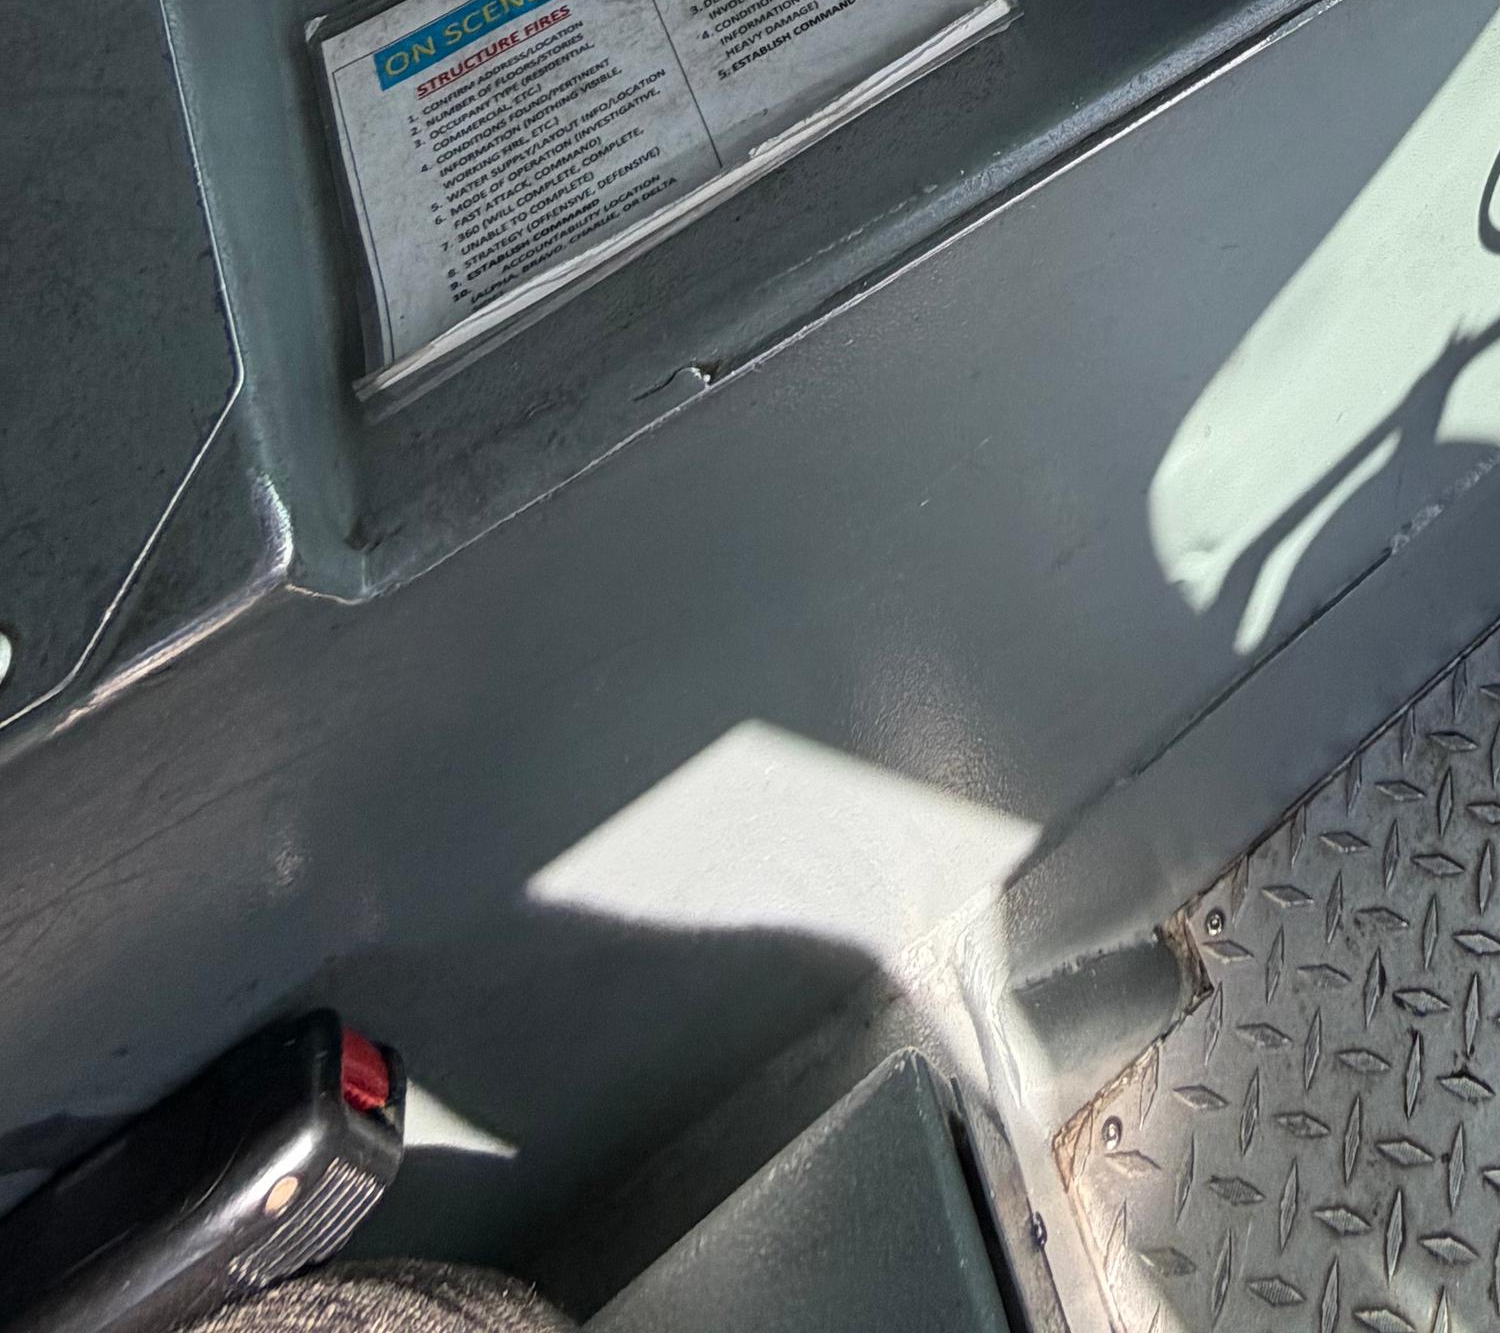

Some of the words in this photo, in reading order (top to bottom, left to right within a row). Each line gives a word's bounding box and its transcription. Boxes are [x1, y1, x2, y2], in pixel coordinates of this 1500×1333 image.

[416, 30, 520, 97] STRUCTURE
[522, 3, 571, 37] FIRES
[689, 2, 703, 15] 3.
[699, 27, 714, 42] 4.
[716, 65, 731, 81] 5.
[730, 30, 792, 73] ESTABLISH
[725, 30, 765, 59] HEAVY
[383, 35, 438, 80] ON
[407, 112, 419, 124] 1.
[422, 79, 475, 116] CONFIRM
[476, 18, 584, 85] ADDRESS/LOCATION
[409, 124, 422, 136] 2.
[425, 93, 476, 128] NUMBER
[477, 83, 493, 98] OF
[494, 31, 584, 87] FLOORS/STORIES
[412, 135, 425, 149] 3.
[492, 82, 518, 103] TYPE
[520, 38, 595, 87] (RESIDENTIAL,
[512, 82, 542, 106] ETC.)
[419, 161, 431, 173] 4.
[434, 117, 508, 166] CONDITIONS
[507, 56, 611, 122] FOUND/PERTINENT
[429, 198, 443, 212] 5.
[445, 172, 489, 204] WATER
[489, 118, 580, 177] SUPPLY/LAYOUT
[580, 67, 666, 123] INFO/LOCATION
[433, 212, 447, 226] 6.
[449, 188, 488, 217] MODE
[488, 177, 505, 193] OF
[506, 137, 572, 183] OPERATION
[573, 84, 660, 142] (INVESTIGATIVE,
[438, 123, 521, 177] INFORMATION
[522, 89, 579, 128] (NOTHING
[579, 63, 623, 95] VISIBLE,
[441, 151, 500, 192] WORKING
[530, 115, 560, 139] ETC.)
[441, 239, 453, 253] 7.
[456, 223, 480, 243] 360
[481, 202, 515, 230] (WILL
[515, 162, 581, 207] COMPLETE,
[580, 124, 644, 168] COMPLETE,
[452, 206, 483, 230] FAST
[533, 134, 602, 182] COMMAND)
[459, 221, 508, 257] UNABLE
[510, 210, 528, 226] TO
[528, 169, 595, 216] COMPLETE)
[463, 226, 524, 270] STRATEGY
[526, 184, 596, 233] (OFFENSIVE,
[595, 144, 662, 191] DEFENSIVE)
[501, 207, 602, 273] ACCOUNTABILITY
[602, 172, 661, 212] LOCATION
[621, 196, 640, 213] OR
[640, 174, 677, 202] DELTA
[465, 238, 530, 282] ESTABLISH
[531, 196, 600, 243] COMMAND
